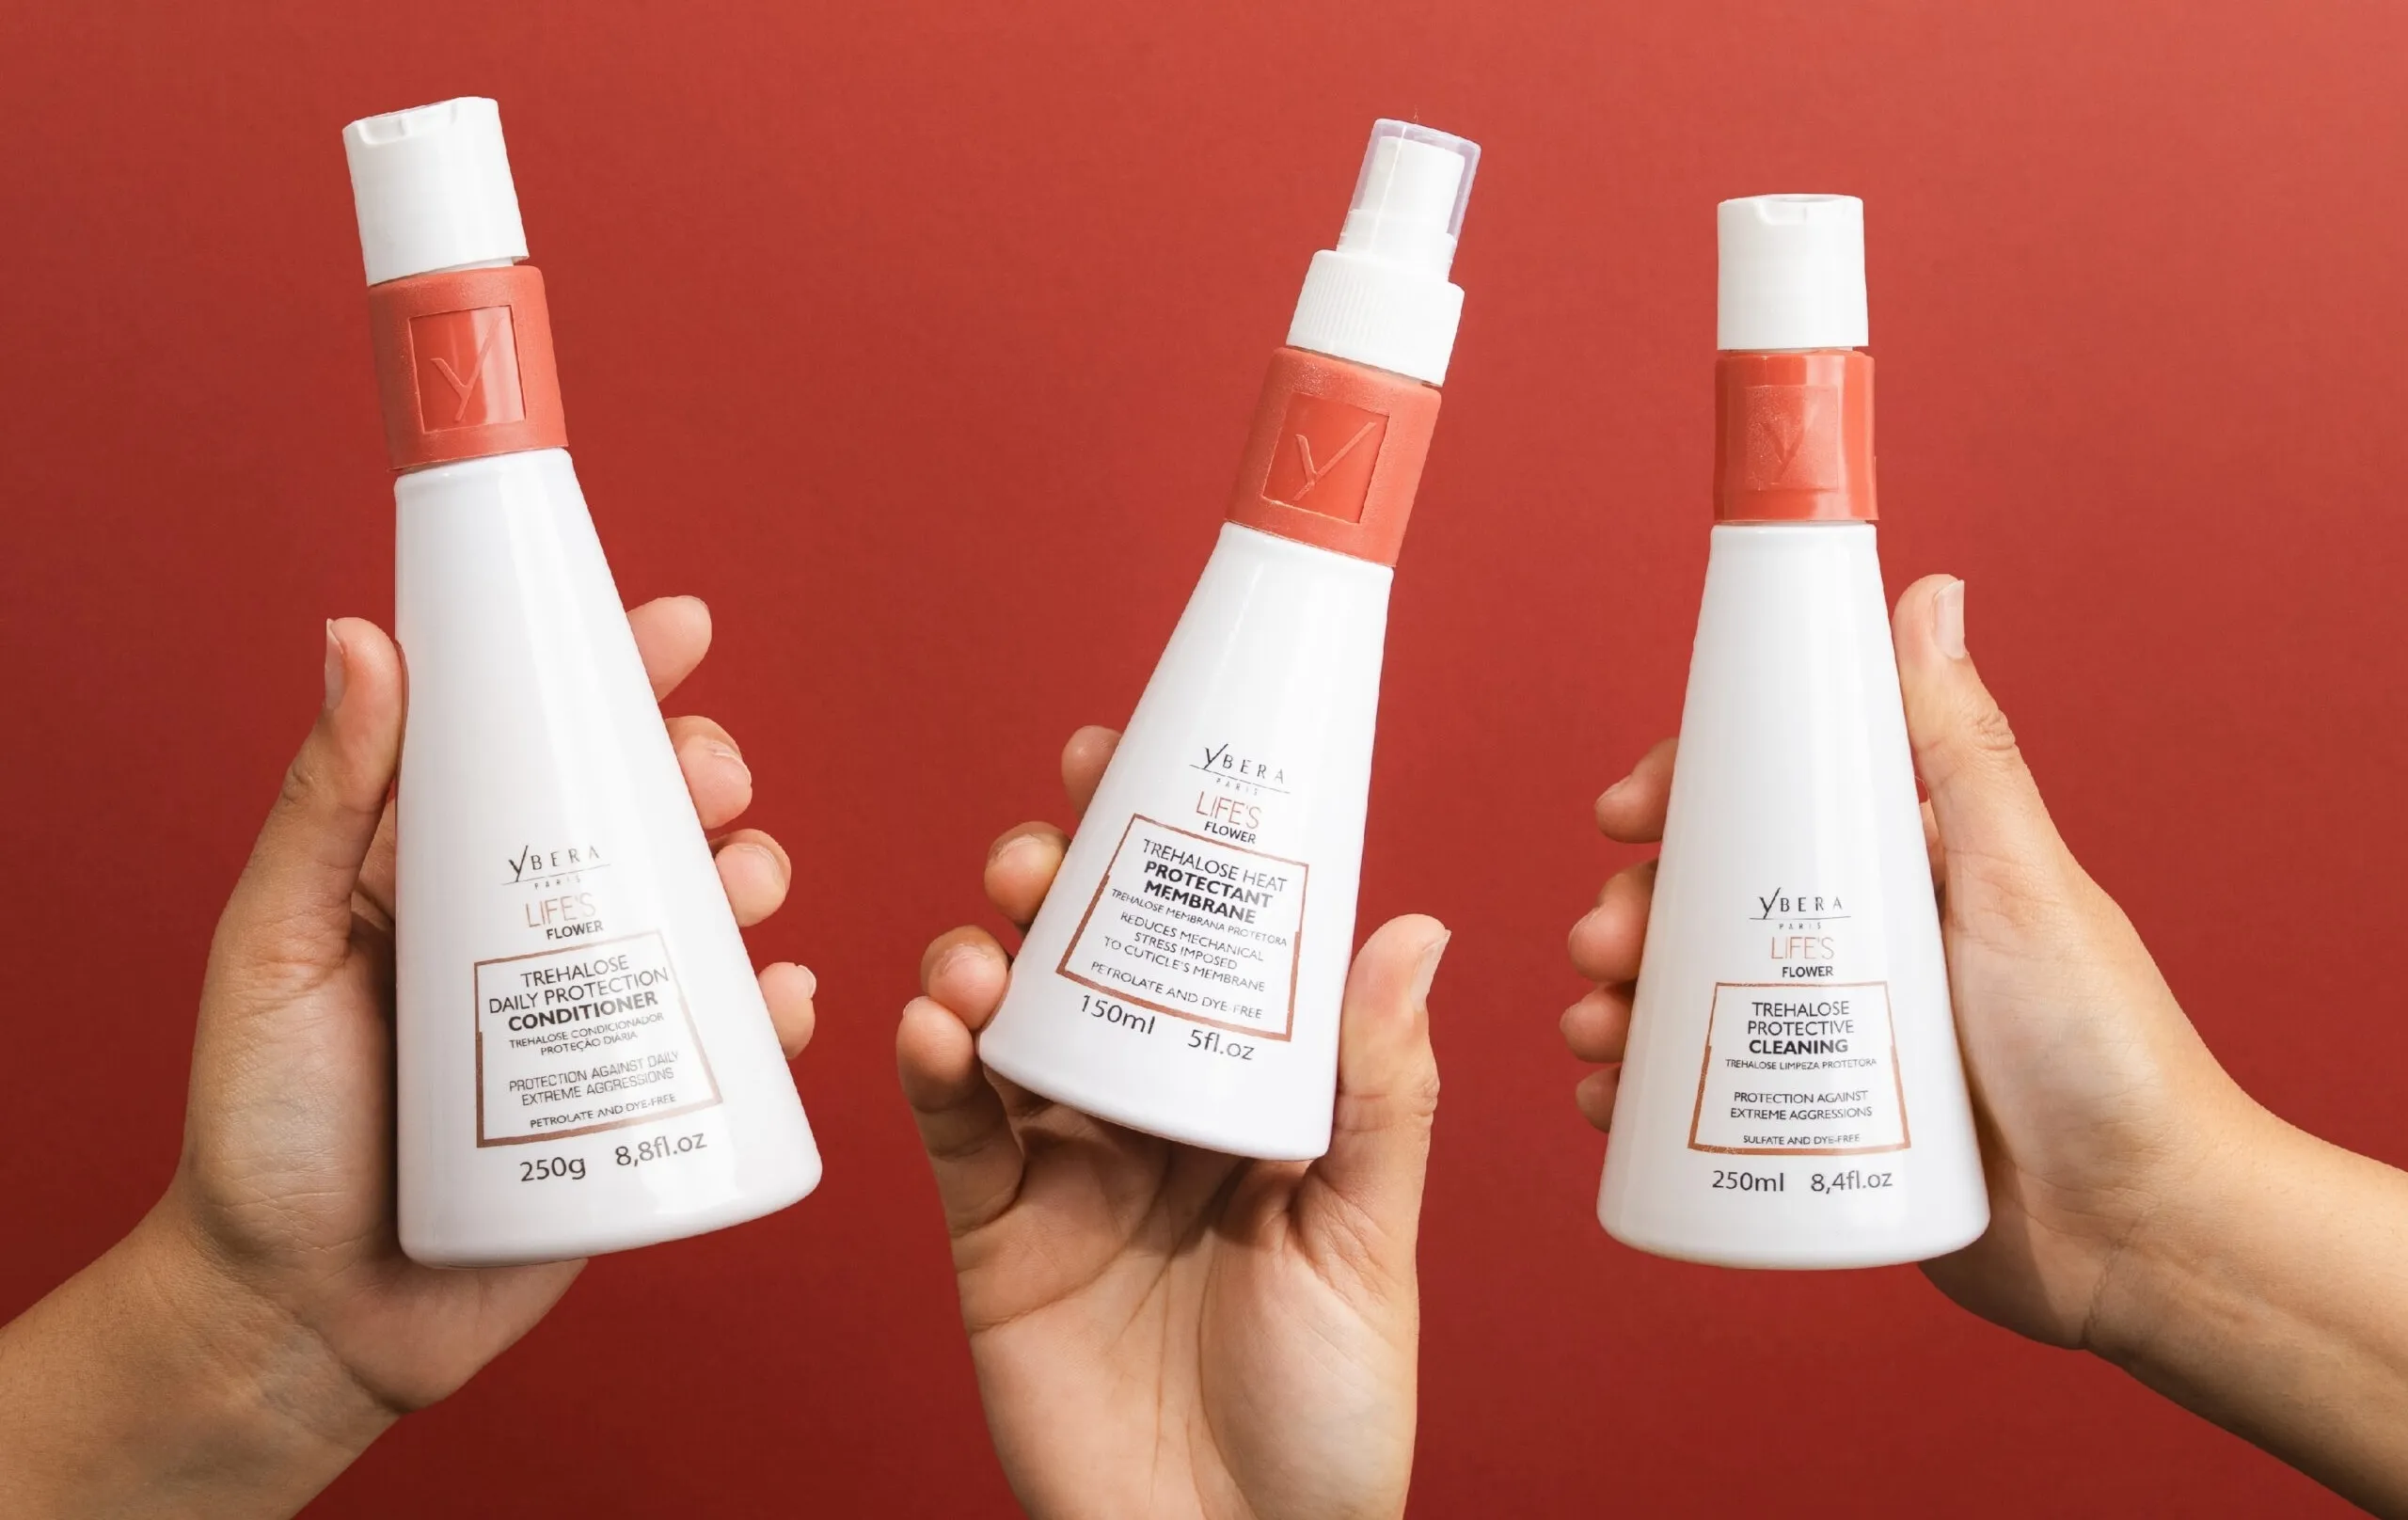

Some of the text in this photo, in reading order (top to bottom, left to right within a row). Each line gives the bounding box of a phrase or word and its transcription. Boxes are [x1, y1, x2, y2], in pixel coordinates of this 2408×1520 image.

[1204, 743, 1284, 784] YBERA
[1196, 791, 1261, 830] LIFE'S
[1205, 821, 1257, 844] FLOWER
[509, 845, 601, 882] YBERA
[1143, 838, 1288, 892] TREHALOSE HEAT
[1144, 863, 1274, 908] PROTECTANT
[1144, 881, 1257, 924] MEMBRANE
[1758, 888, 1843, 920] YBERA
[525, 893, 596, 928] LIFE'S
[1111, 889, 1287, 946] TREHALOSE MEMBRANA PROTETORA
[547, 920, 603, 940] FLOWER
[1120, 912, 1263, 961] REDUCES MECHANICAL
[1771, 937, 1834, 959] LIFE'S
[1104, 936, 1265, 991] TO CUTICLE'S MEMBRANE
[1134, 932, 1238, 970] STRESS IMPOSED
[520, 955, 629, 988] TREHALOSE
[1782, 966, 1833, 977] FLOWER
[489, 967, 669, 1014] DAILY PROTECTION
[1091, 961, 1263, 1020] PETROLATE AND DYE-FREE
[1751, 1001, 1850, 1017] TREHALOSE
[508, 990, 658, 1032] CONDITIONER
[1080, 994, 1256, 1060] 150ml 5fl.oz
[1748, 1020, 1854, 1036] PROTECTIVE
[509, 1012, 665, 1049] TREHALOSE CONDICIONADOR
[1749, 1039, 1848, 1054] CLEANING
[509, 1051, 679, 1092] PROTECTION AGAINST DAILY
[1725, 1058, 1877, 1069] TREHALOSE LIMPEZA PROTETORA
[521, 1068, 674, 1106] EXTREME AGGRESSIONS
[1734, 1090, 1868, 1104] PROTECTION AGAINST
[530, 1093, 676, 1129] PETROLATE AND DYE-FREE
[1730, 1107, 1873, 1120] EXTREME AGGRESSIONS
[520, 1132, 707, 1182] 250g 8,8fl.oz
[1743, 1134, 1861, 1145] SULFATE AND DYE-FREE
[1712, 1170, 1893, 1195] 250ml 8,4fl.oz
